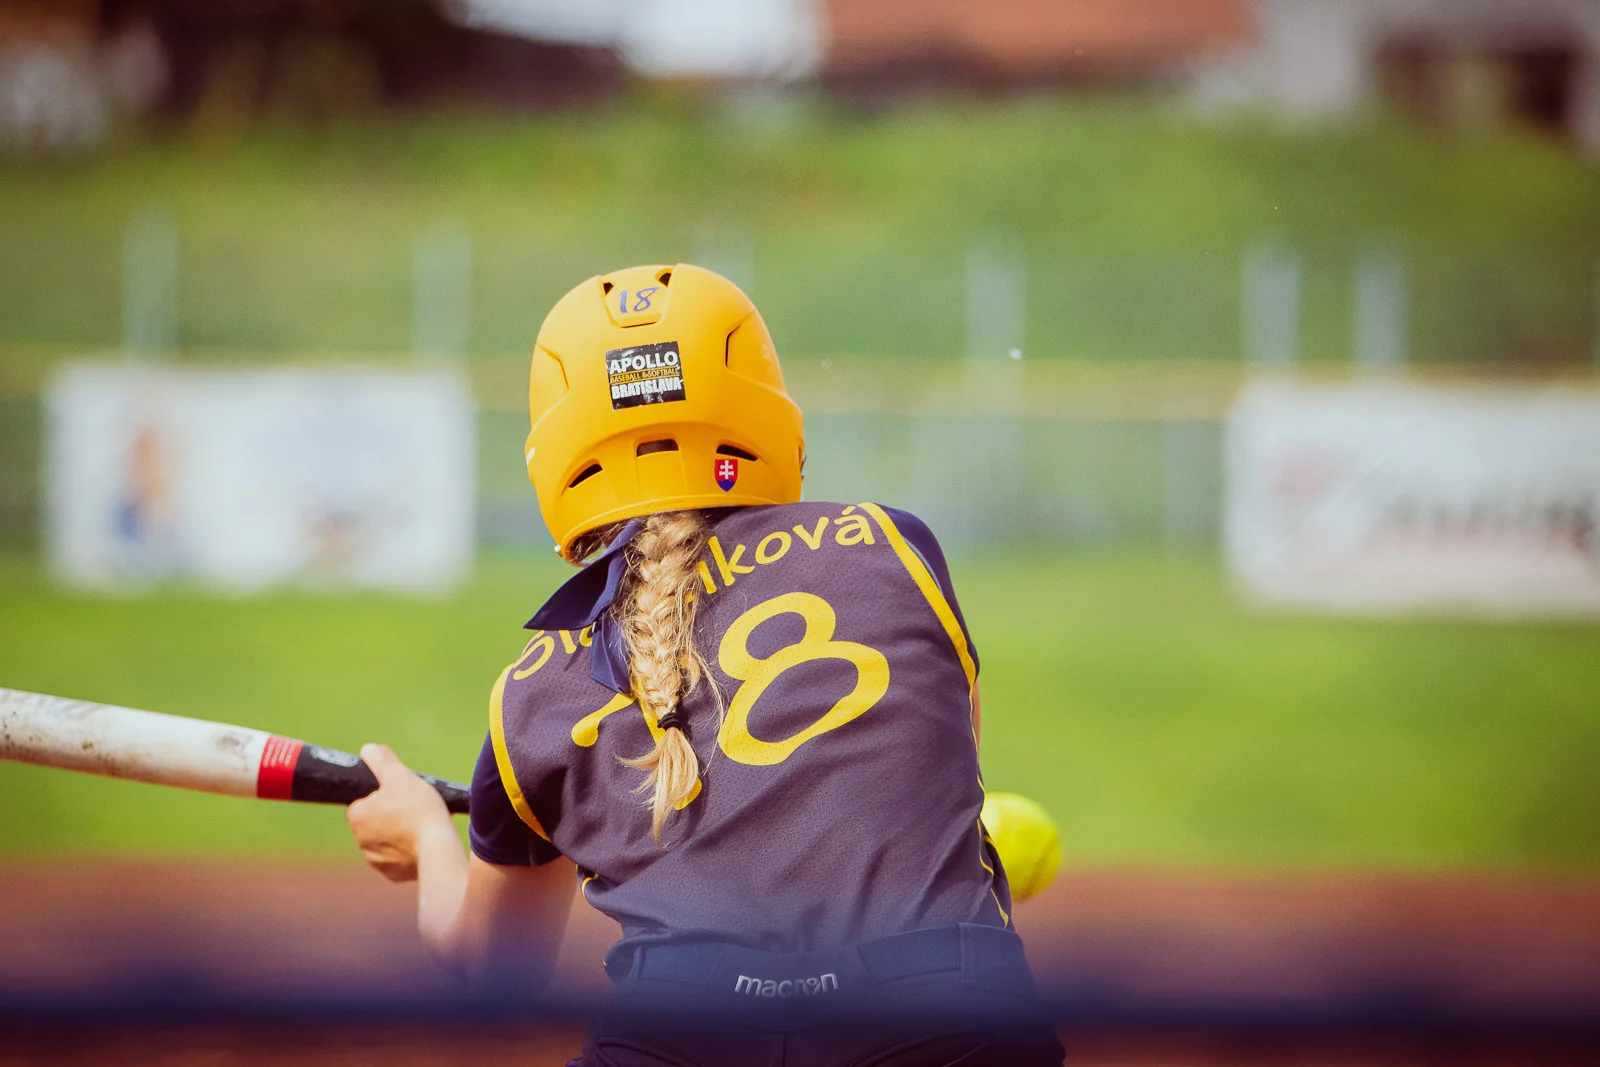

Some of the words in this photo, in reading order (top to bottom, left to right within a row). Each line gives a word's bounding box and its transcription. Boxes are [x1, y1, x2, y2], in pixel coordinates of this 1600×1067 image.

[618, 286, 661, 314] 18
[609, 351, 679, 375] APOLLO
[610, 372, 642, 384] BASEBALL
[611, 376, 682, 400] BRATISLAVA
[734, 972, 839, 998] macron
